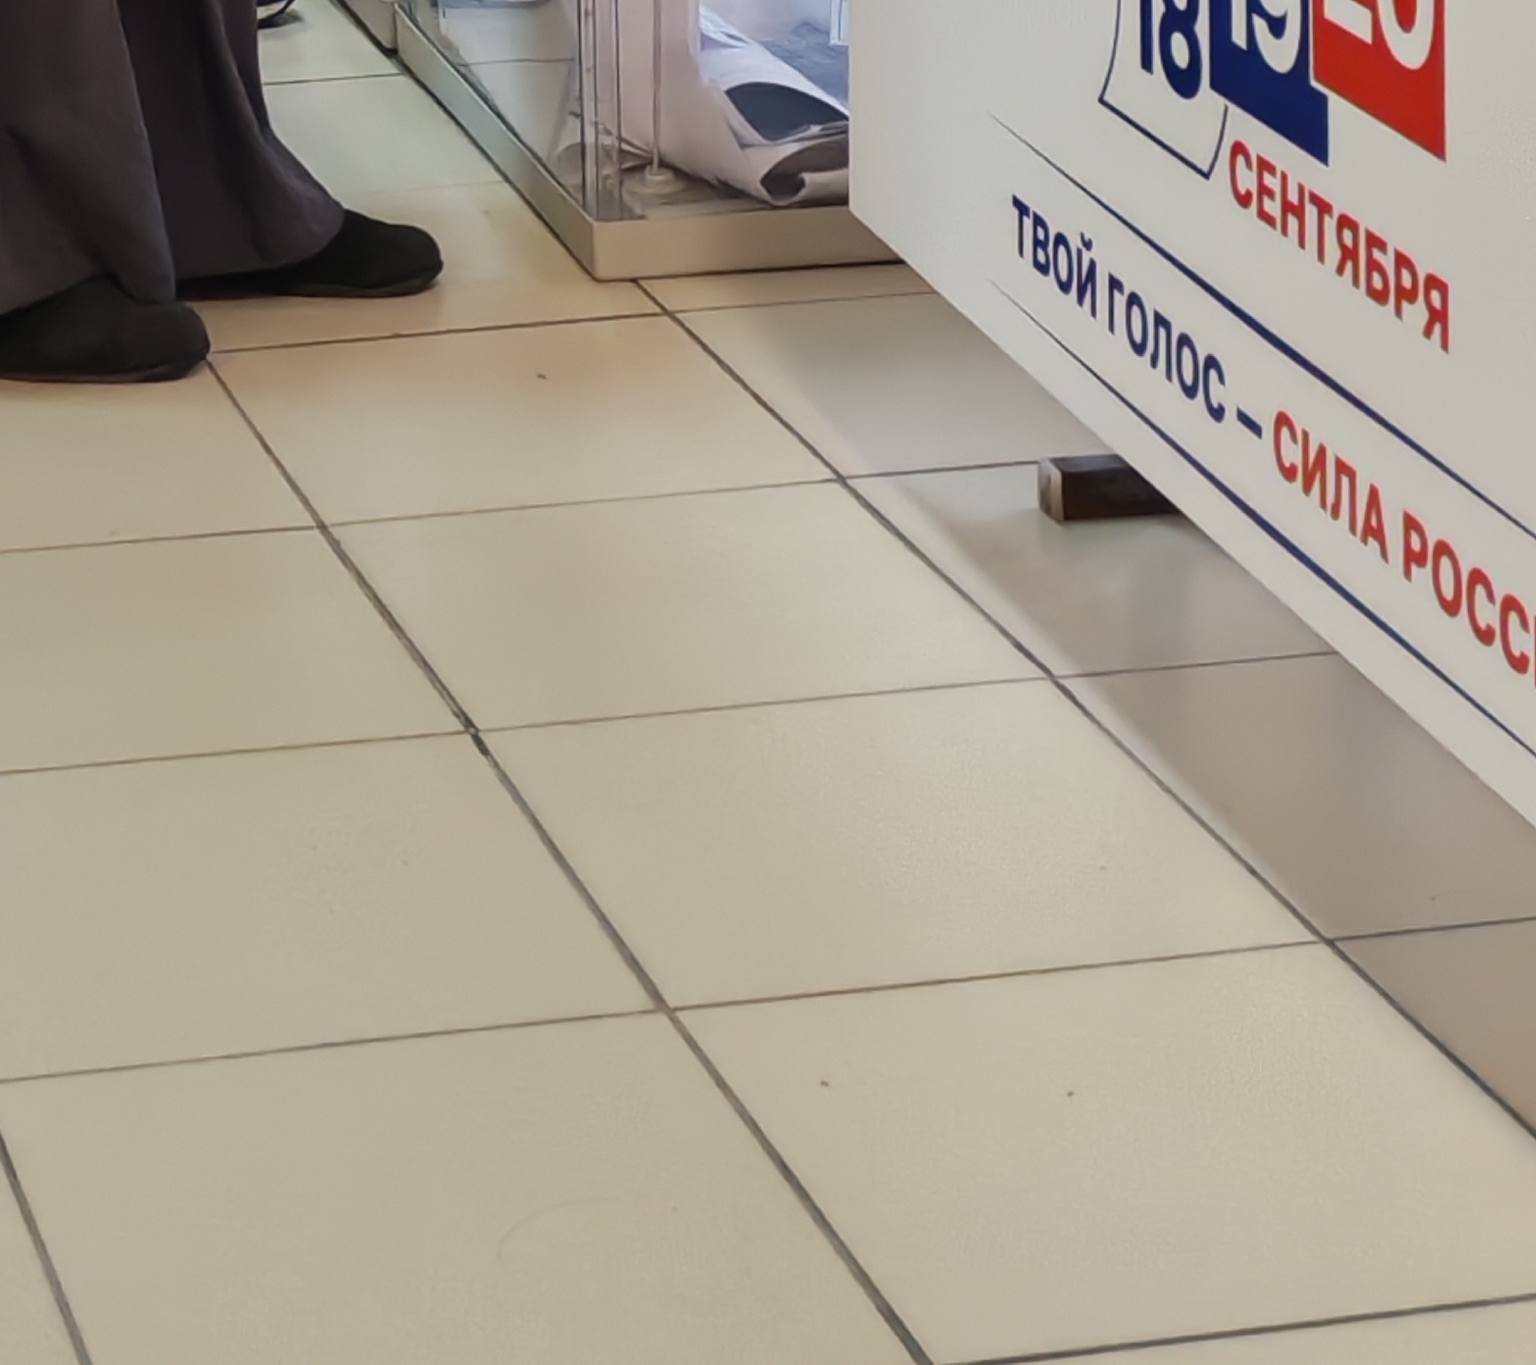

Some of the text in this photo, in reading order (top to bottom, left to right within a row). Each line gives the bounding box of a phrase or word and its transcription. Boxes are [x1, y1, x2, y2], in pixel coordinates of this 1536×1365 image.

[1228, 139, 1451, 353] СЕНТЯБРЯ
[1011, 194, 1097, 319] ТВОЙ
[1107, 272, 1227, 424] ГОЛОС
[1272, 410, 1390, 564] СИЛА
[1402, 508, 1536, 688] РОСС
